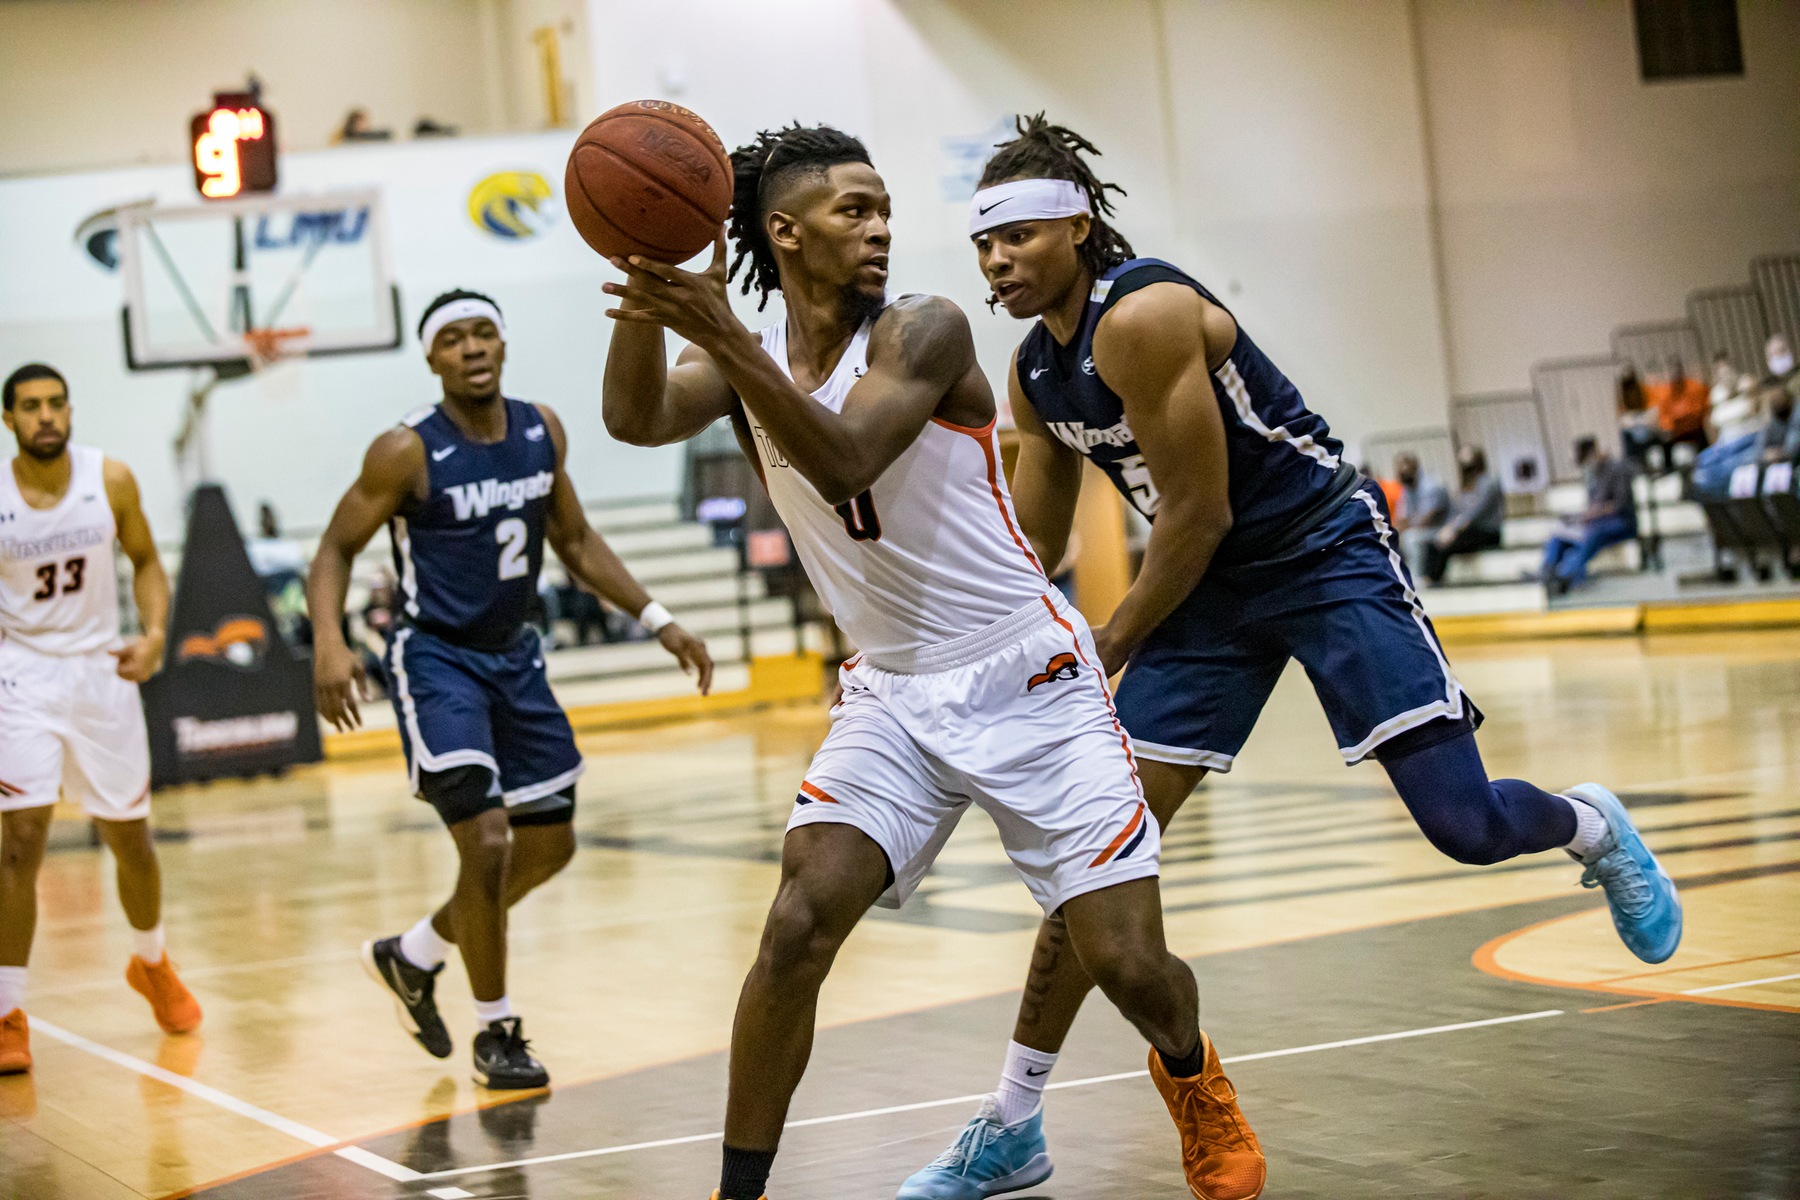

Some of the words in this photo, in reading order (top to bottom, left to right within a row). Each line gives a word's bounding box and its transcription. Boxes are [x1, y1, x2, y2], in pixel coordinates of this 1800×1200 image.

[1046, 413, 1135, 454] Winga
[1111, 453, 1161, 516] 5
[495, 517, 529, 580] 2
[33, 555, 87, 602] 33
